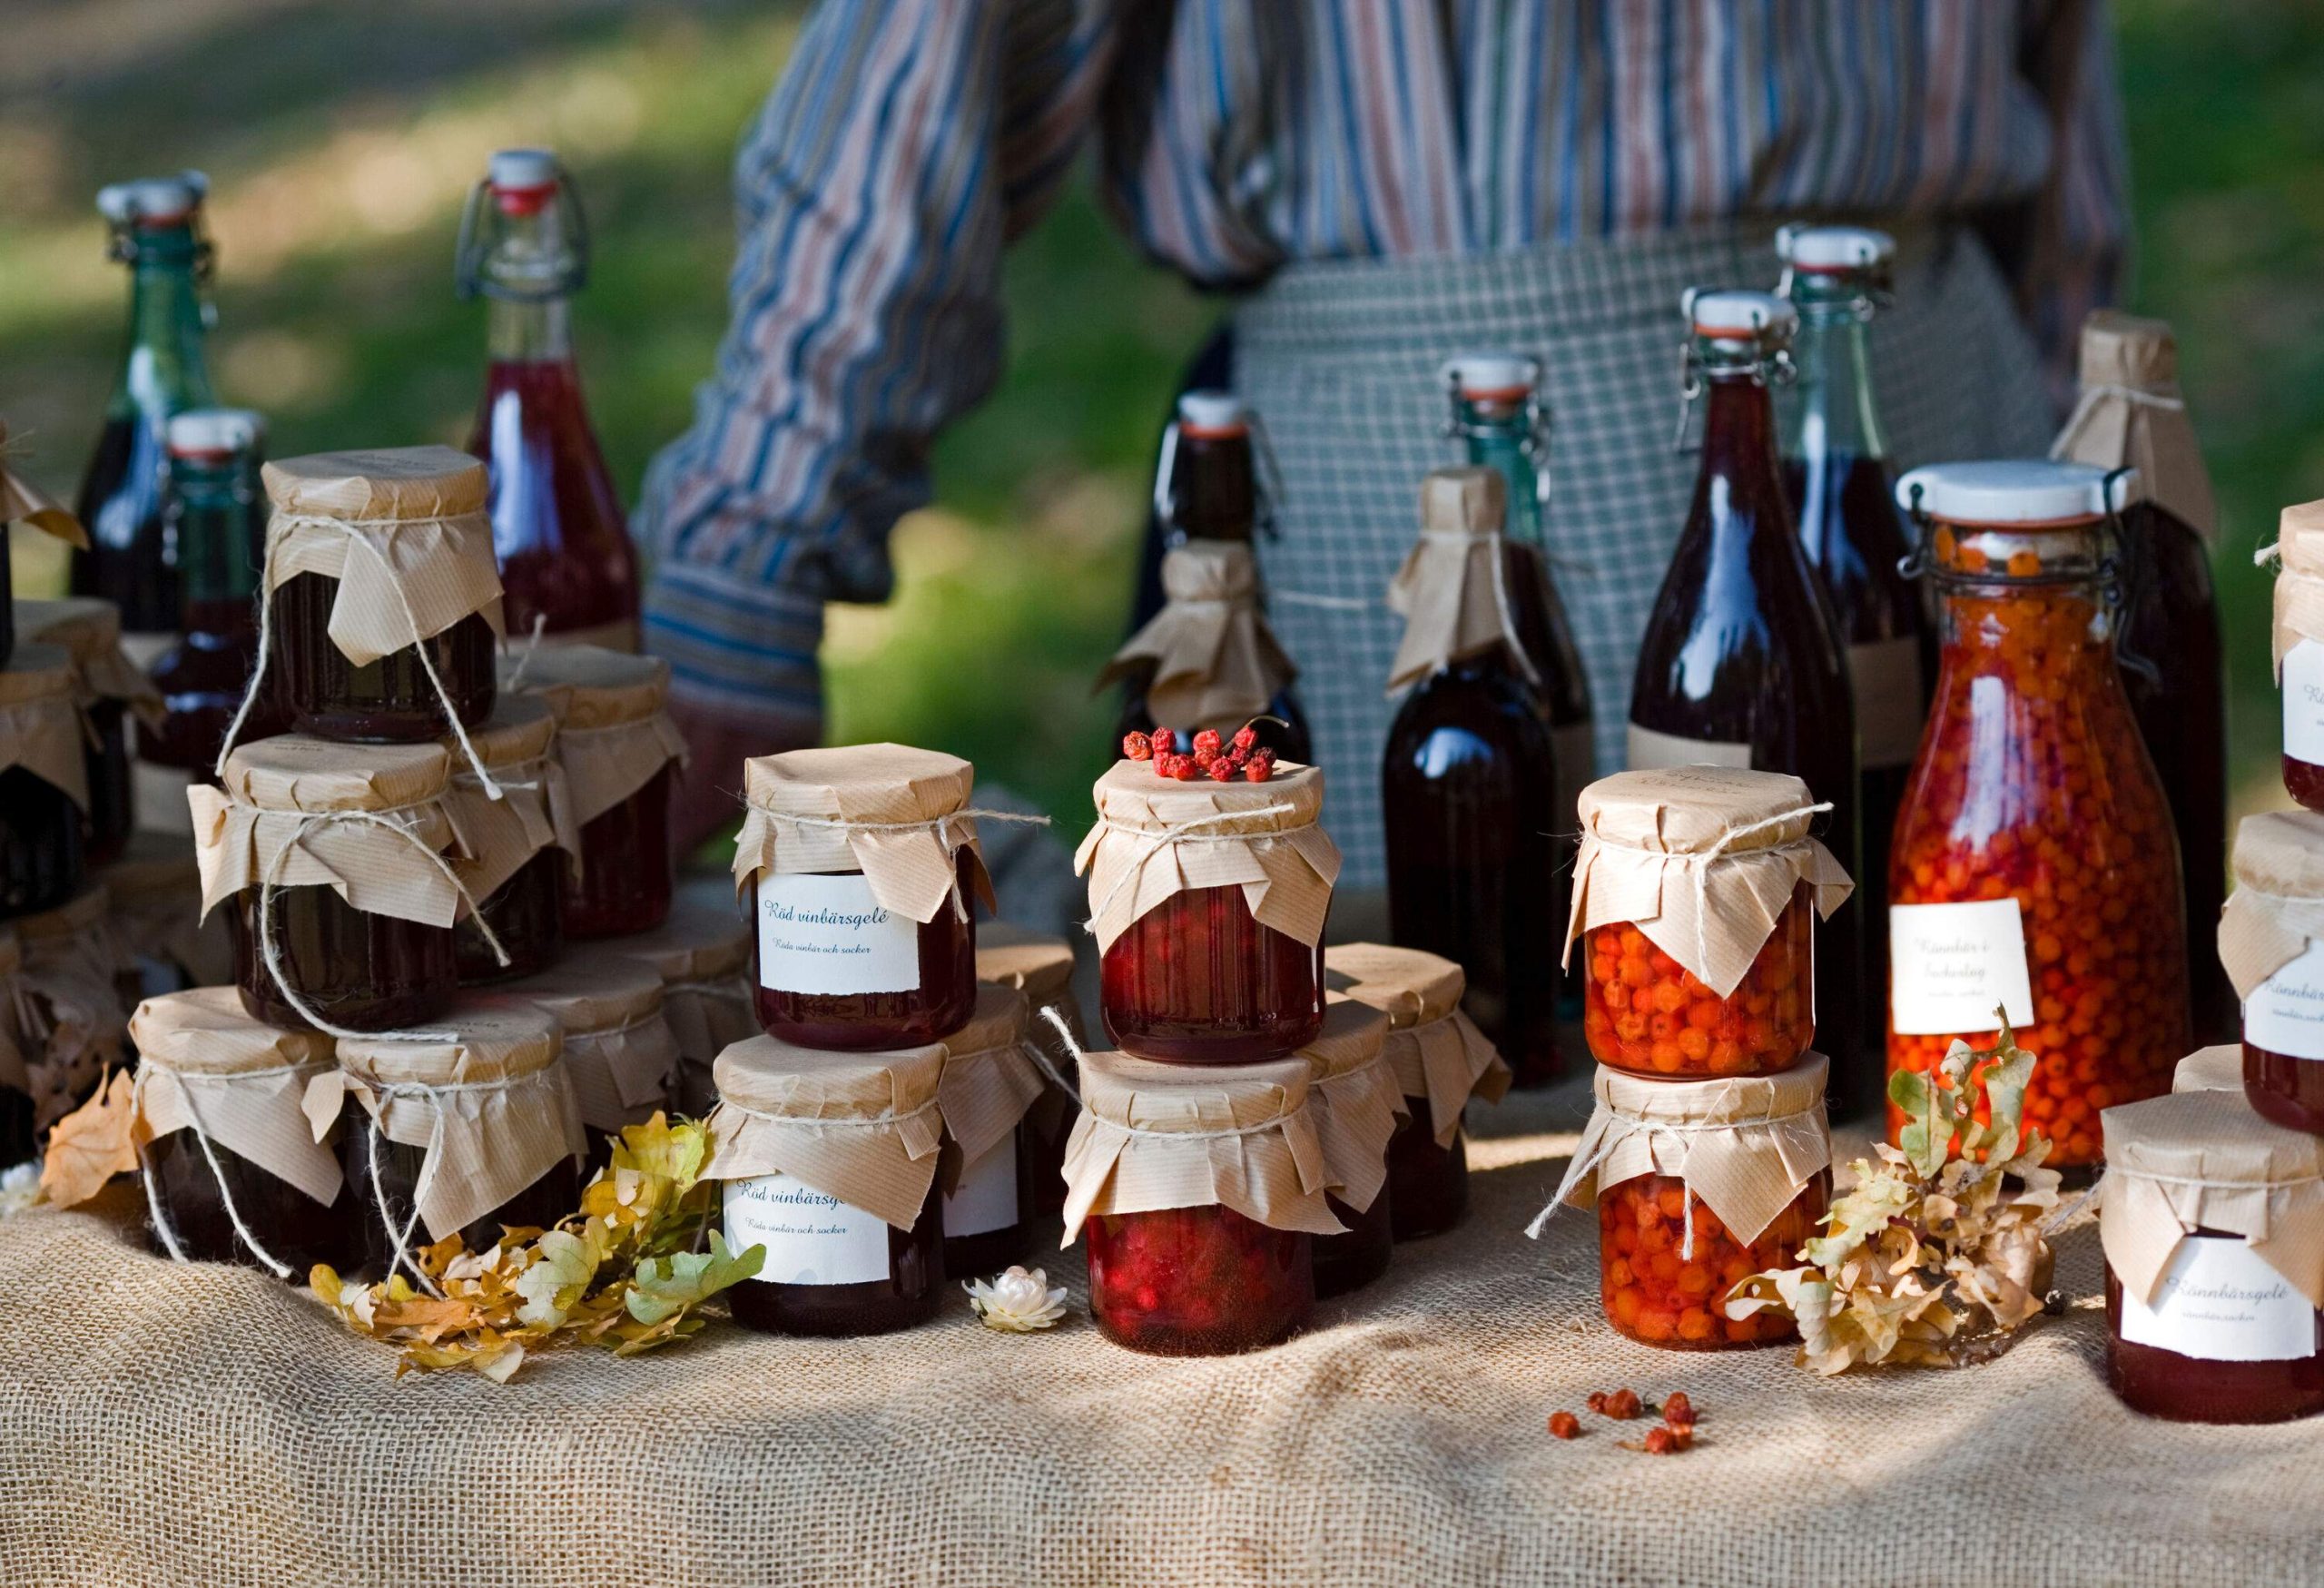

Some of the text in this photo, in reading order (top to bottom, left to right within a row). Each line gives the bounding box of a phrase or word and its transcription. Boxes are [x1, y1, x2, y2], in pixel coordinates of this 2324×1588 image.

[764, 899, 889, 930] Röd vinbärsgelé
[772, 937, 872, 954] Röda vinbär och socker
[736, 1179, 769, 1201] Röd
[744, 1216, 849, 1235] Röda vinbär och socker
